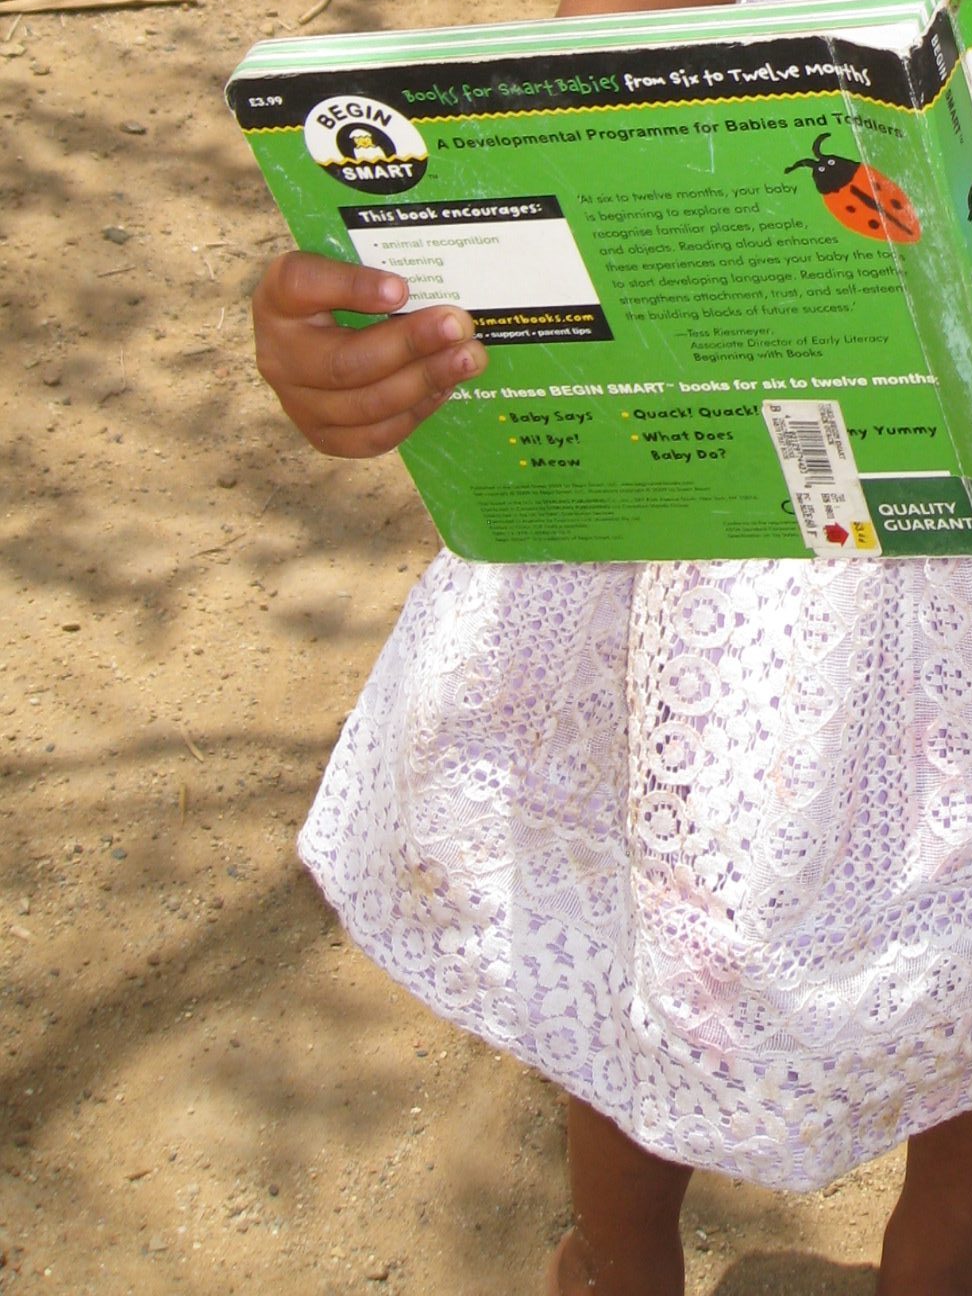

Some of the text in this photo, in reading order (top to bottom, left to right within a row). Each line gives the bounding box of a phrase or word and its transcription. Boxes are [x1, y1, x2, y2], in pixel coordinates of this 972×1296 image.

[930, 33, 947, 81] BEGIN
[401, 83, 459, 105] Books
[462, 83, 493, 103] for
[498, 77, 552, 97] Smart
[553, 74, 619, 95] Babies
[623, 73, 666, 93] from
[669, 68, 699, 88] Six
[703, 70, 724, 87] to
[727, 62, 800, 83] Twelve
[248, 95, 283, 108] £3.99
[316, 102, 393, 131] BEGIN
[946, 88, 961, 136] SMART
[437, 112, 903, 150] A Developmental Programme for Babies and Toddlers
[342, 162, 414, 181] SMART
[597, 194, 612, 203] six
[616, 194, 629, 203] to
[632, 190, 673, 201] twelve
[676, 188, 729, 201] months,
[733, 186, 760, 198] your
[765, 183, 798, 196] baby
[358, 204, 543, 223] This book encourages:
[585, 203, 760, 222] is beginning to explore and
[592, 218, 808, 240] recognise familiar places, people,
[381, 235, 500, 250] animal recognition
[599, 235, 839, 256] and objects. Reading aloud enhances
[389, 256, 444, 268] listening
[605, 261, 639, 272] these
[642, 258, 715, 272] experiences
[719, 256, 744, 266] and
[748, 256, 781, 267] gives
[784, 255, 812, 267] your
[815, 252, 849, 263] baby
[853, 250, 874, 259] the
[612, 281, 625, 290] to
[628, 277, 655, 288] start
[658, 275, 729, 287] developing
[730, 270, 797, 284] language.
[800, 271, 854, 281] Reading
[409, 290, 460, 302] mitating
[619, 293, 690, 306] strengthens
[693, 290, 768, 304] attachment,
[771, 287, 802, 299] trust,
[806, 287, 831, 296] and
[472, 313, 594, 326] nsmartbooks.com
[625, 311, 645, 321] the
[649, 310, 699, 321] building
[702, 307, 742, 318] blocks
[746, 307, 758, 316] of
[761, 303, 798, 314] future
[537, 328, 570, 337] parent
[690, 335, 889, 350] Associate Director of Early Literacy
[693, 349, 823, 365] Beginning with Books
[474, 388, 497, 400] for
[500, 387, 546, 399] these
[549, 384, 604, 397] BEGIN
[678, 381, 731, 393] books
[733, 378, 758, 390] for
[762, 378, 786, 390] six
[789, 378, 808, 389] to
[811, 376, 868, 388] twelve
[509, 410, 593, 425] Baby Says
[633, 405, 760, 420] Quack! Quack!
[642, 430, 734, 443] What Does
[872, 424, 937, 437] Yummy
[519, 434, 581, 448] Hi! Bye!
[530, 458, 581, 468] Meow
[651, 448, 727, 463] Baby Do?
[878, 502, 955, 516] QUALITY
